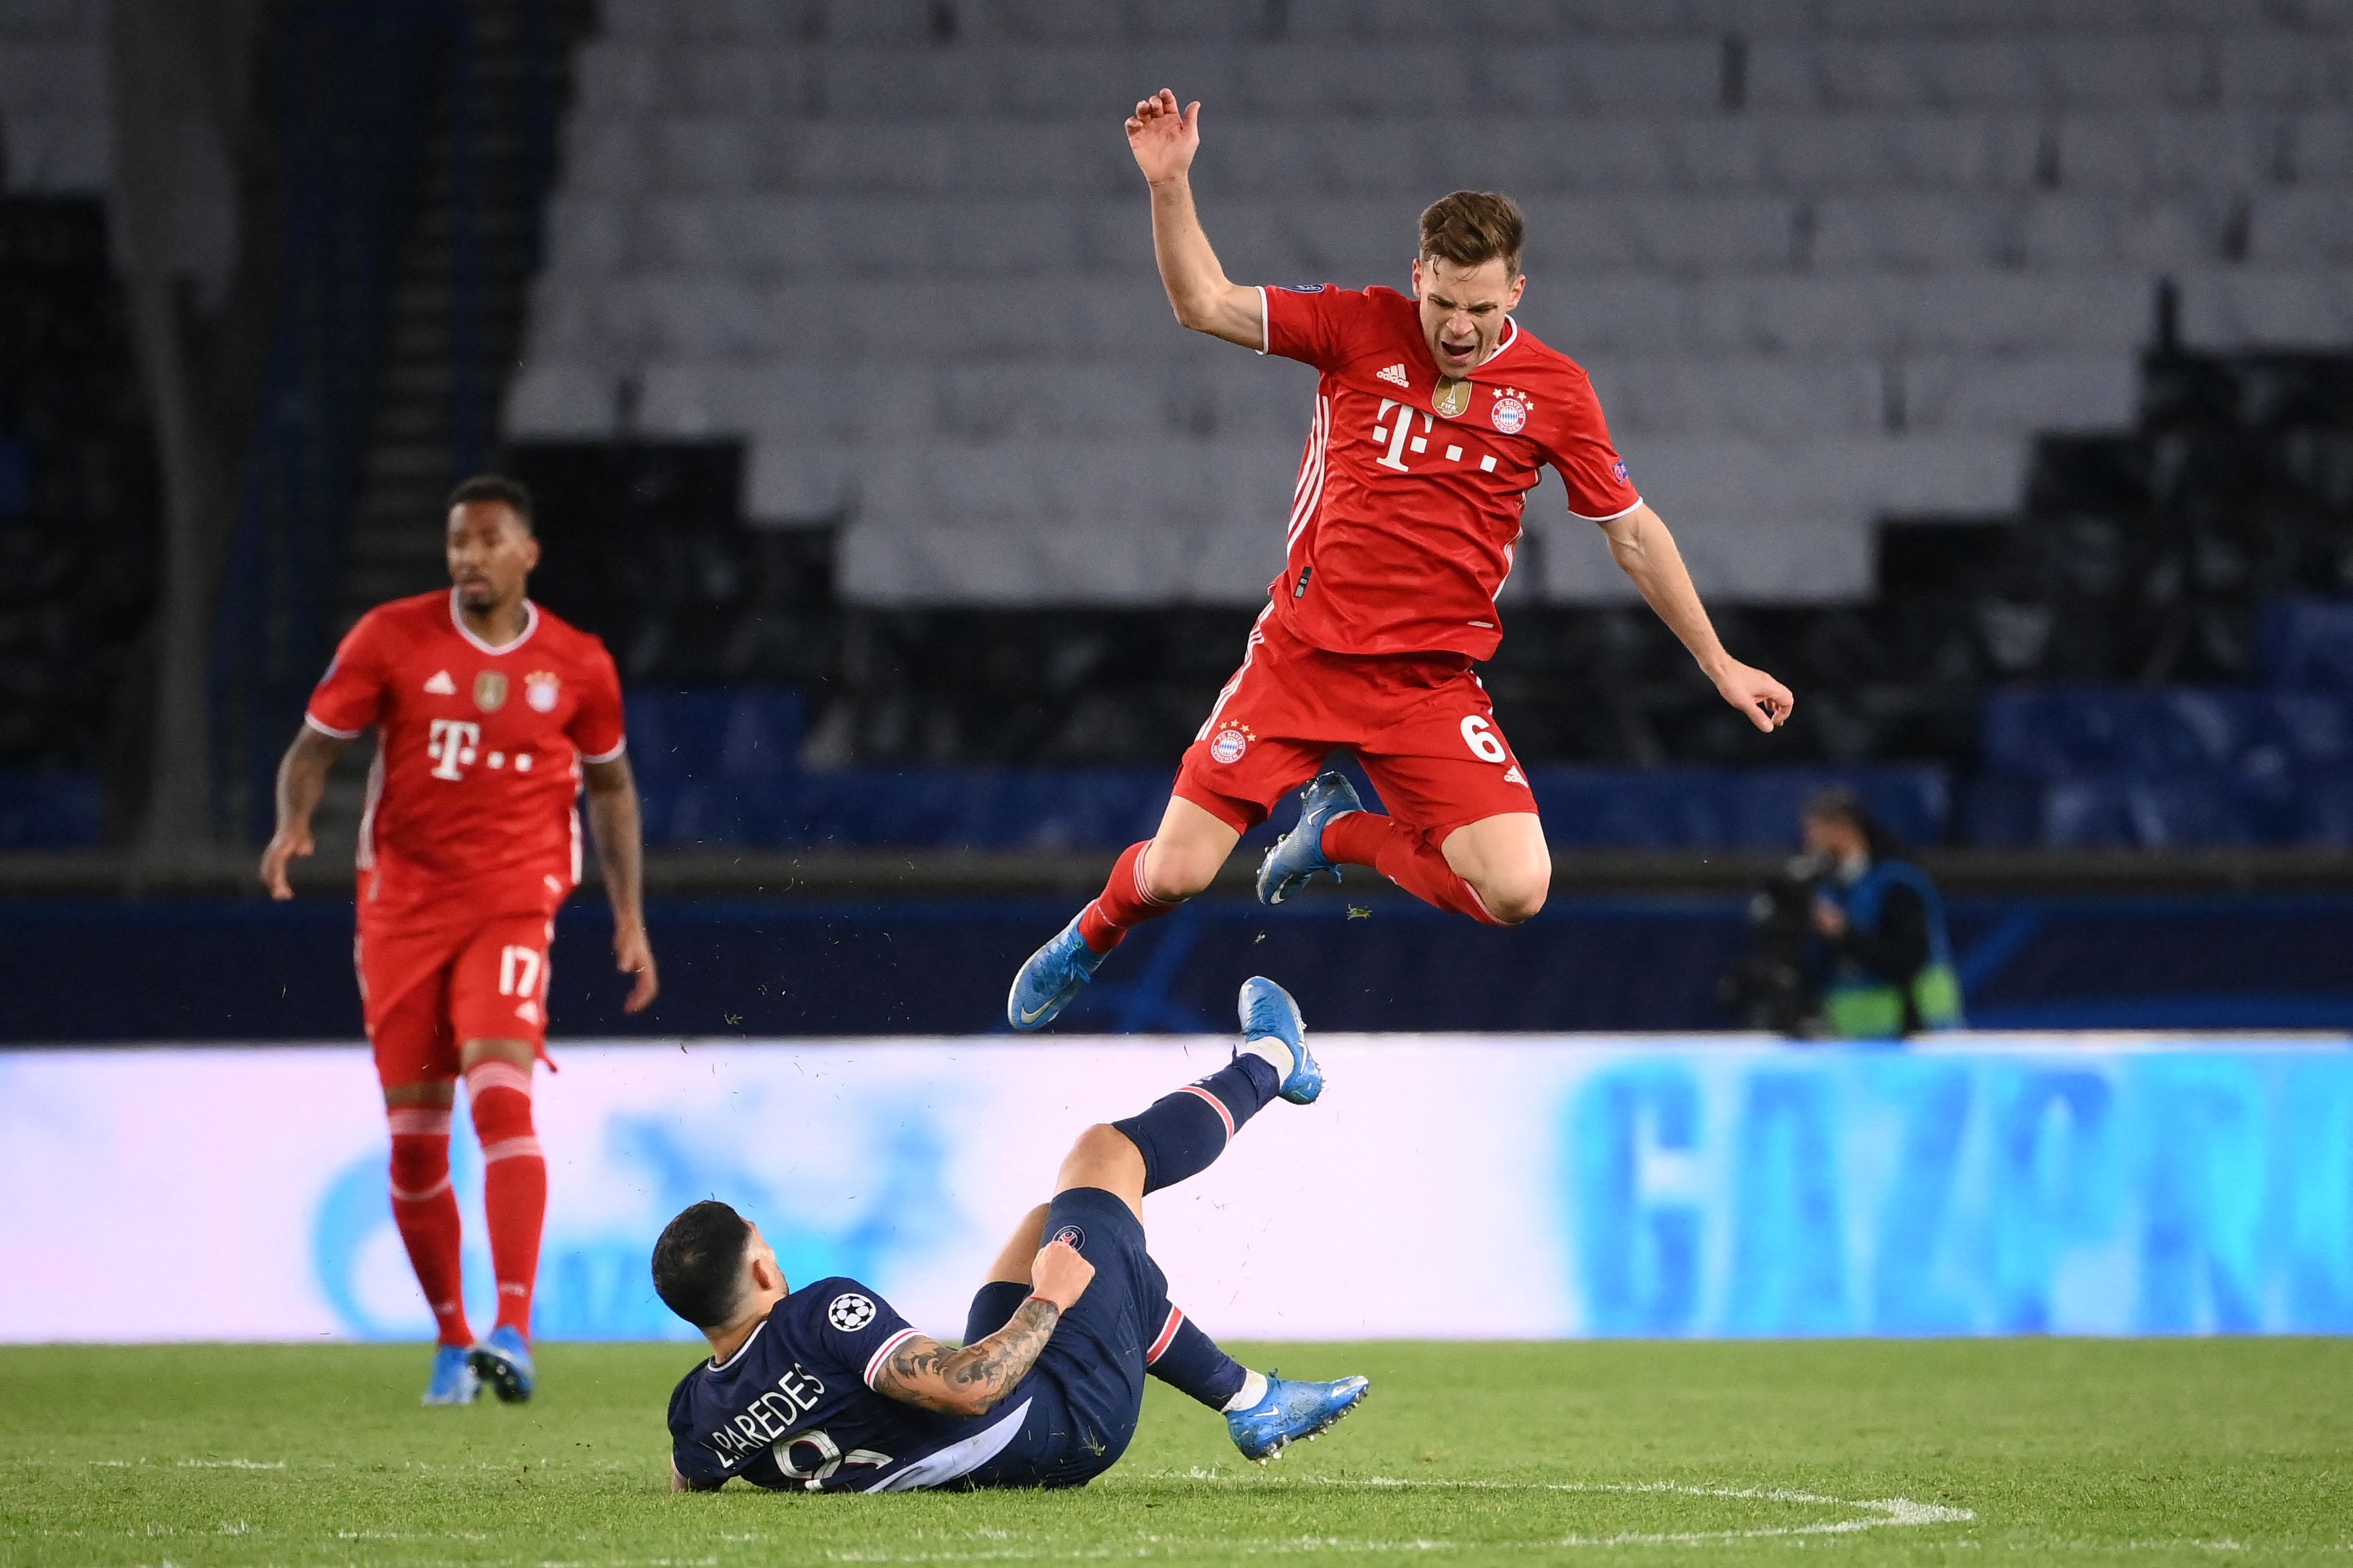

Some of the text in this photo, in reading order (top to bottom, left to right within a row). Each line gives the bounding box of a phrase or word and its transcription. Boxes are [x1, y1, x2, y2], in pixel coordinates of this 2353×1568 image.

[1376, 370, 1410, 388] adidas
[1440, 401, 1458, 411] FIFA
[1505, 400, 1524, 418] BAYERN
[1460, 714, 1506, 763] 6
[498, 945, 540, 998] 17
